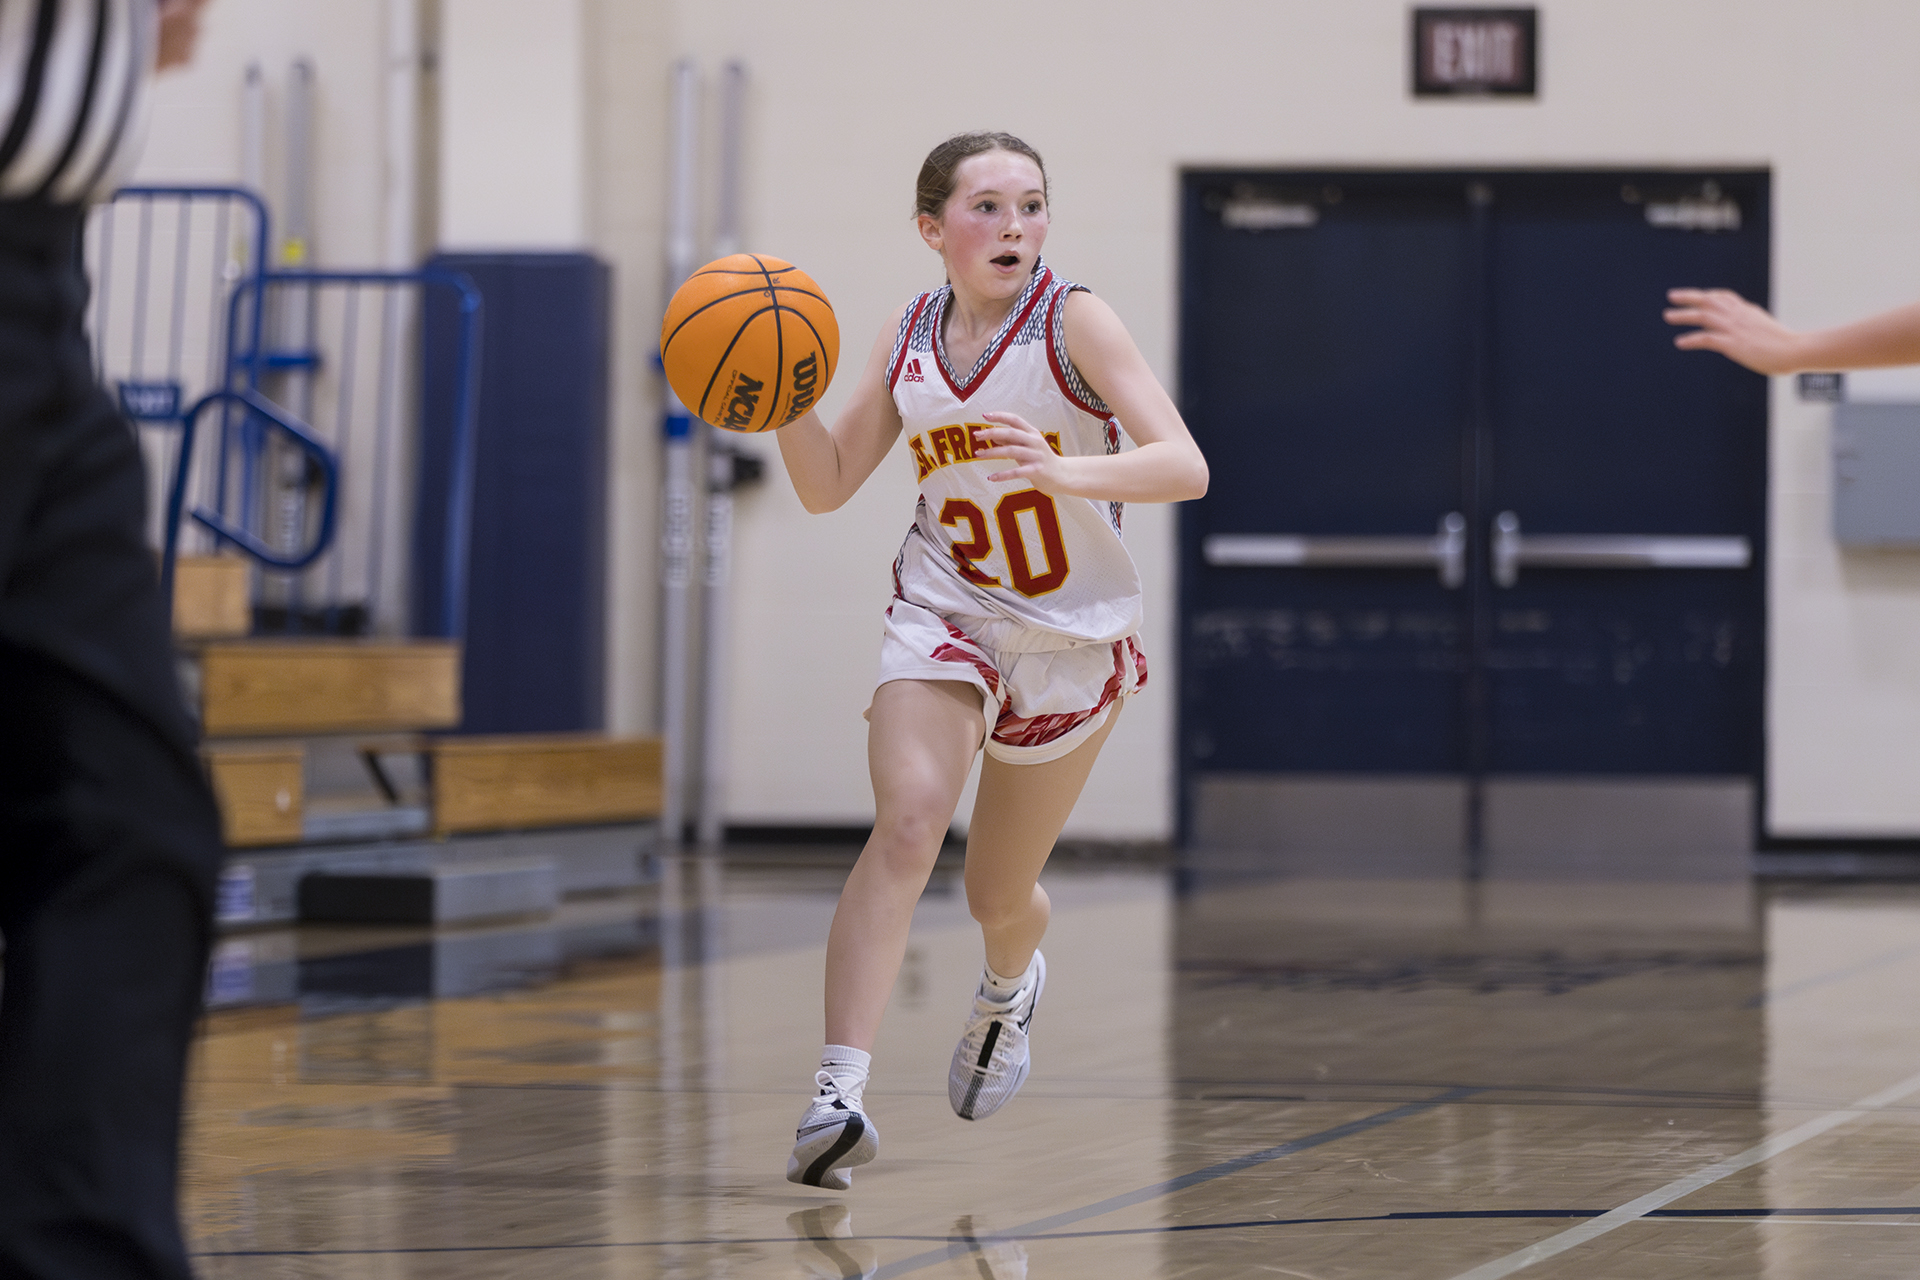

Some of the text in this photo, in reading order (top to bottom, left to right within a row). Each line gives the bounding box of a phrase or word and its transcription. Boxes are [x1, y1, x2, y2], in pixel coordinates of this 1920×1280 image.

[1431, 21, 1518, 81] EXIT
[927, 422, 1064, 468] FRAS
[938, 487, 1071, 599] 20
